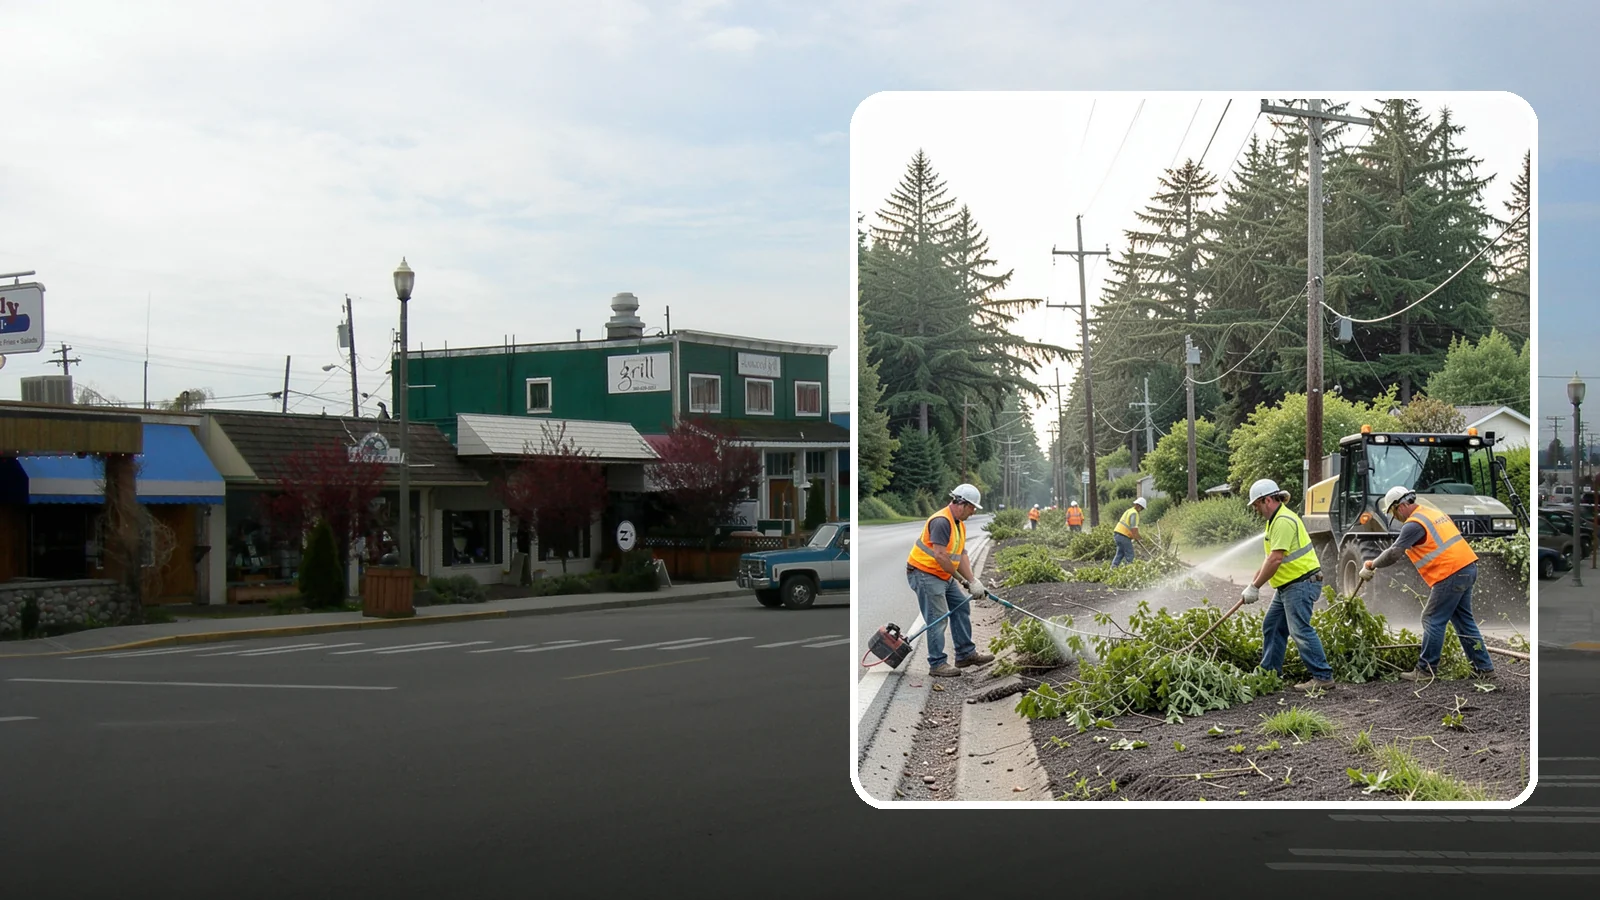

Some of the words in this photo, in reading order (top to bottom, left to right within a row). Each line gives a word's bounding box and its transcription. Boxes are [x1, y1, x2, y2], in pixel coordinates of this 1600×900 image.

[3, 338, 16, 346] Fries
[20, 336, 38, 345] Salads
[618, 356, 655, 392] grill
